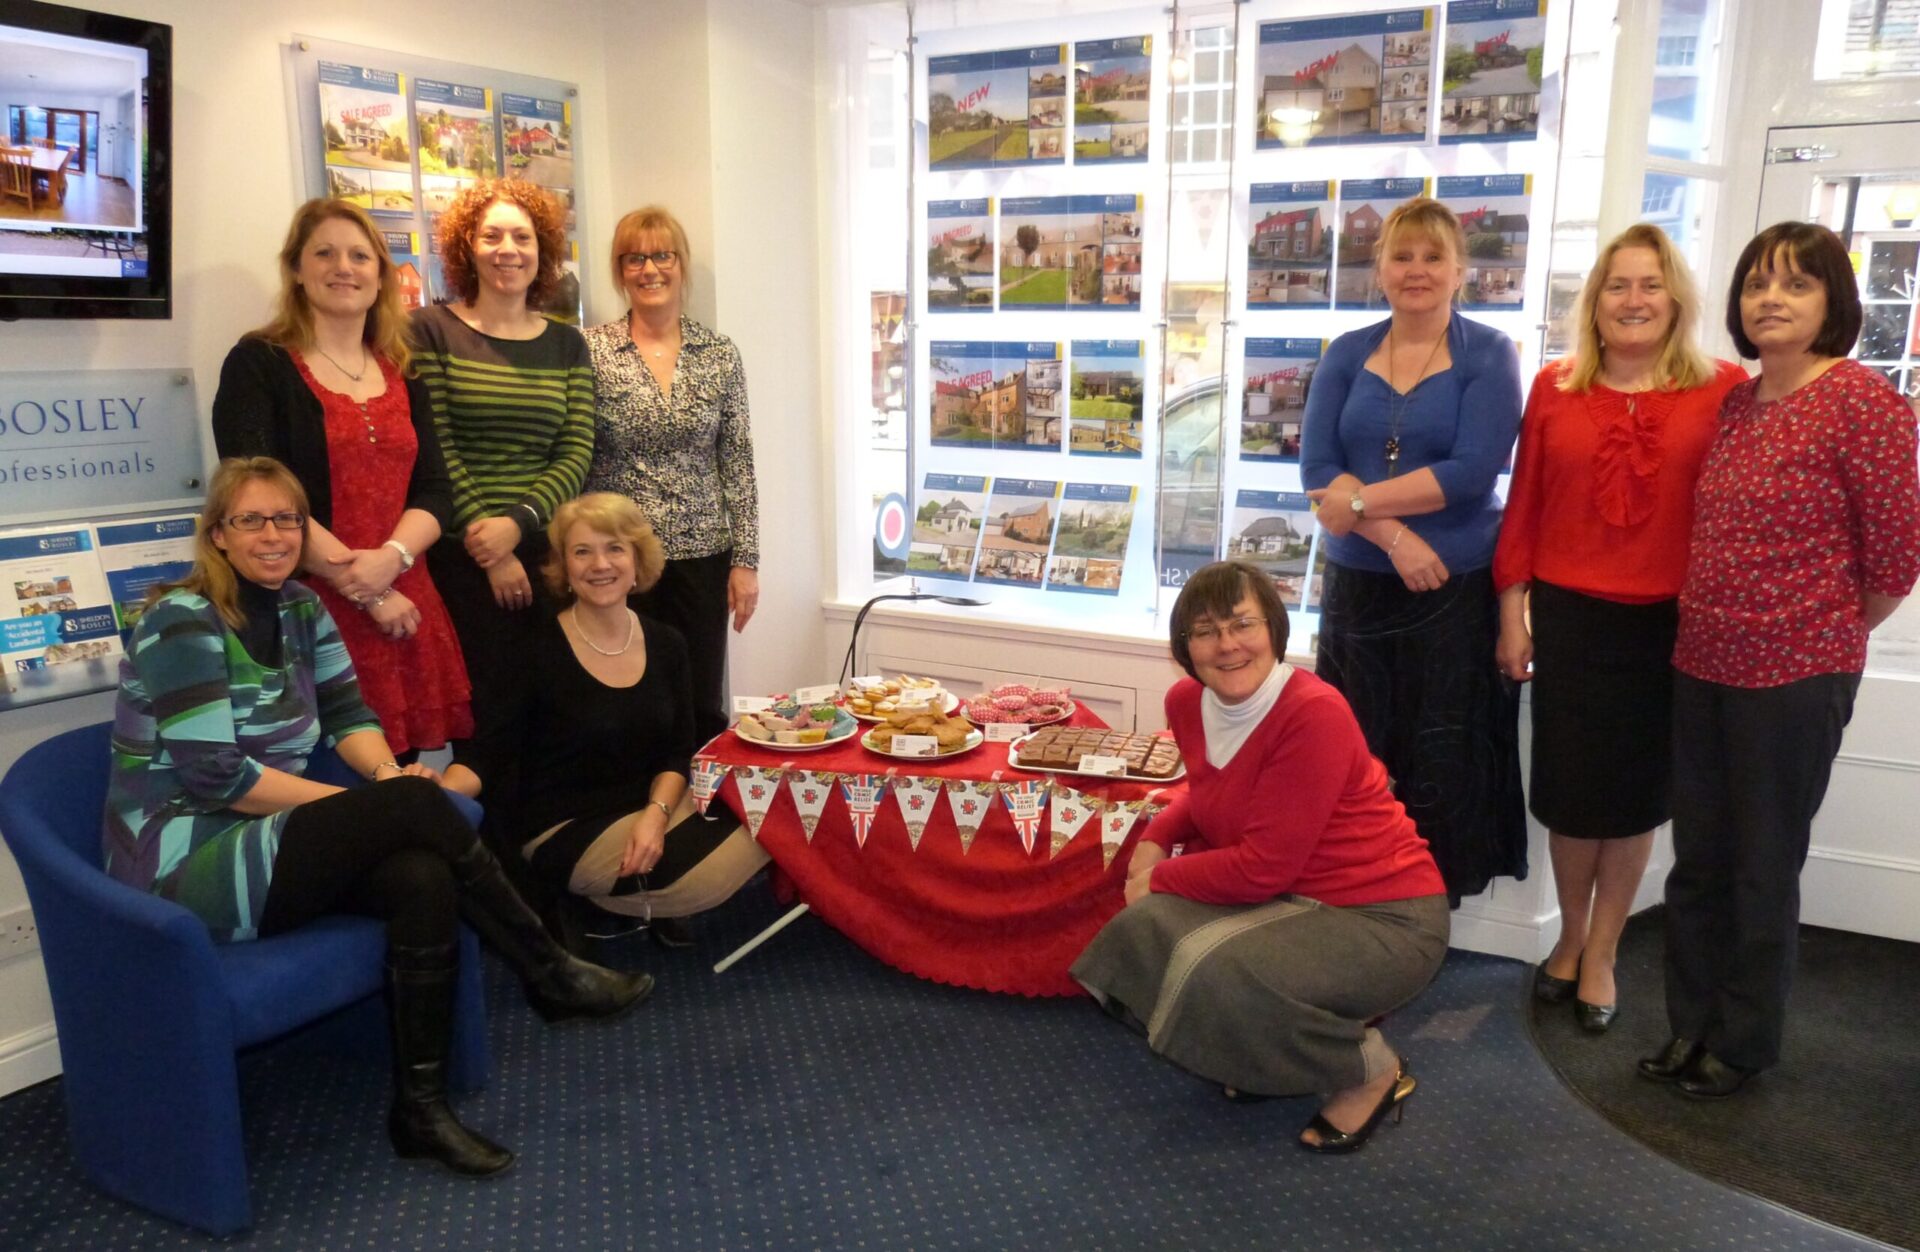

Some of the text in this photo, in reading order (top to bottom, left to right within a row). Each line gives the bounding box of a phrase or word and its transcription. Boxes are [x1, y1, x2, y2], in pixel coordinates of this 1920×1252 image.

[956, 80, 991, 112] NEW
[362, 104, 391, 119] AGREED
[79, 614, 111, 623] SHELDON
[80, 620, 112, 630] BOSLEY
